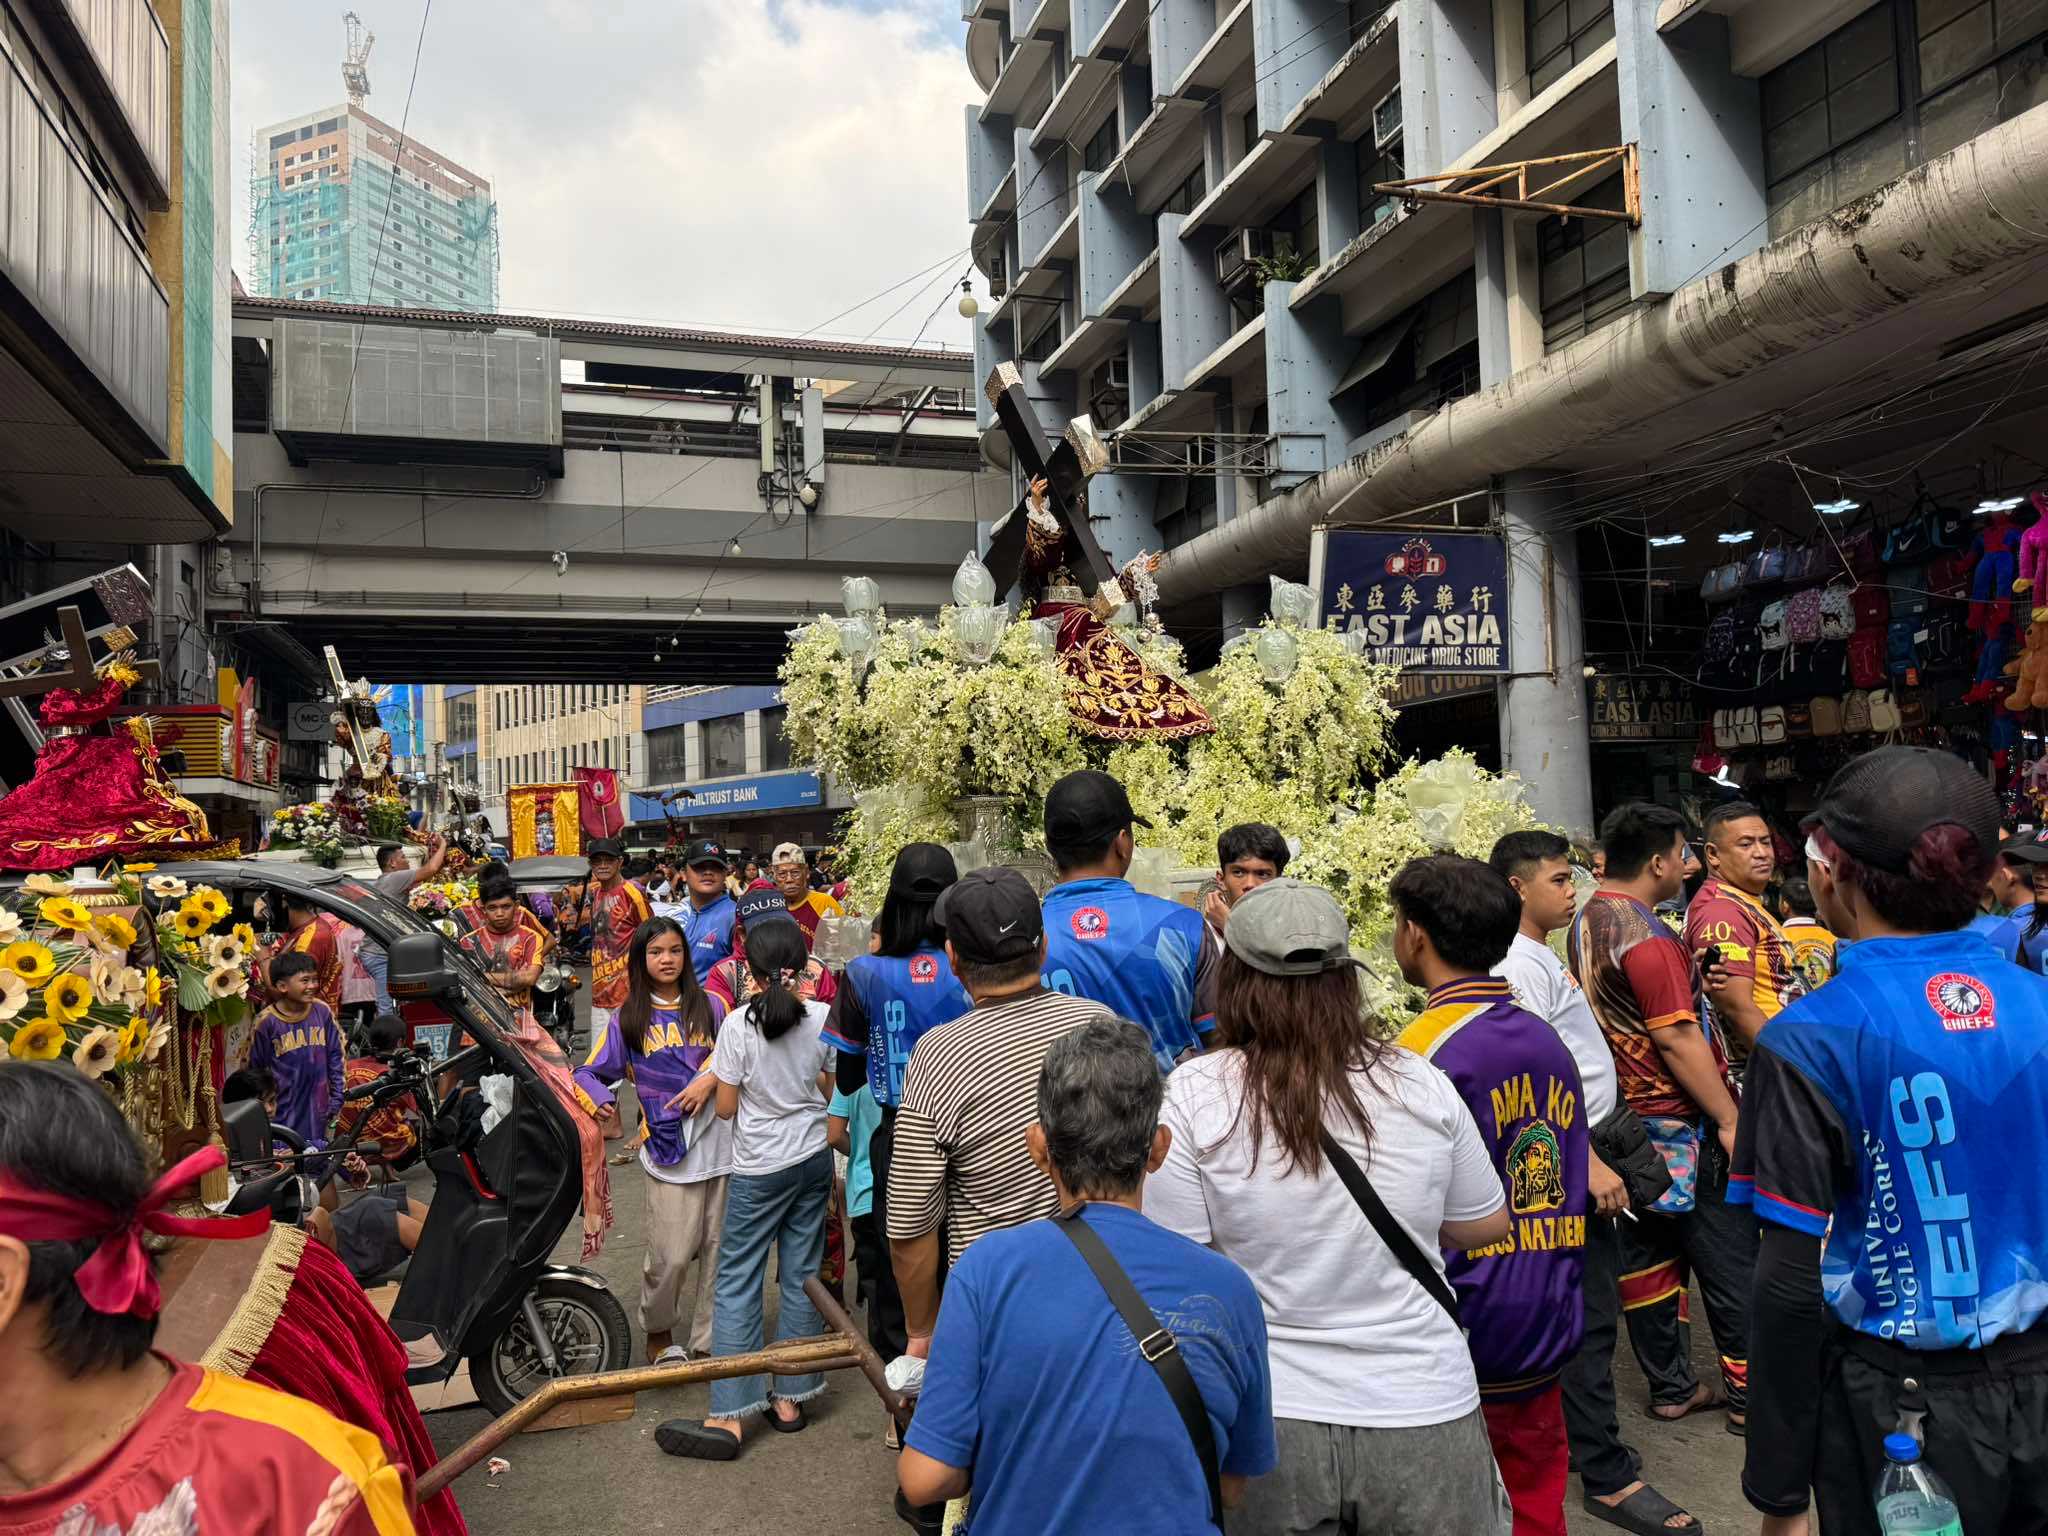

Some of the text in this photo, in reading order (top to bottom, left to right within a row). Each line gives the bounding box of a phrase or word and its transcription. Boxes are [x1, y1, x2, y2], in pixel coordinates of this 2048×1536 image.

[1327, 614, 1502, 646] EAST ASIA
[1375, 647, 1429, 665] MEDICINE
[1432, 647, 1462, 666] DRUG
[1465, 647, 1500, 666] STORE
[1592, 701, 1696, 723] EAST ASIA
[734, 786, 759, 803] BANK
[1943, 1016, 1995, 1031] CHIEFS
[1490, 1072, 1576, 1139] AMA KO
[1893, 1241, 1918, 1338] BUGLE
